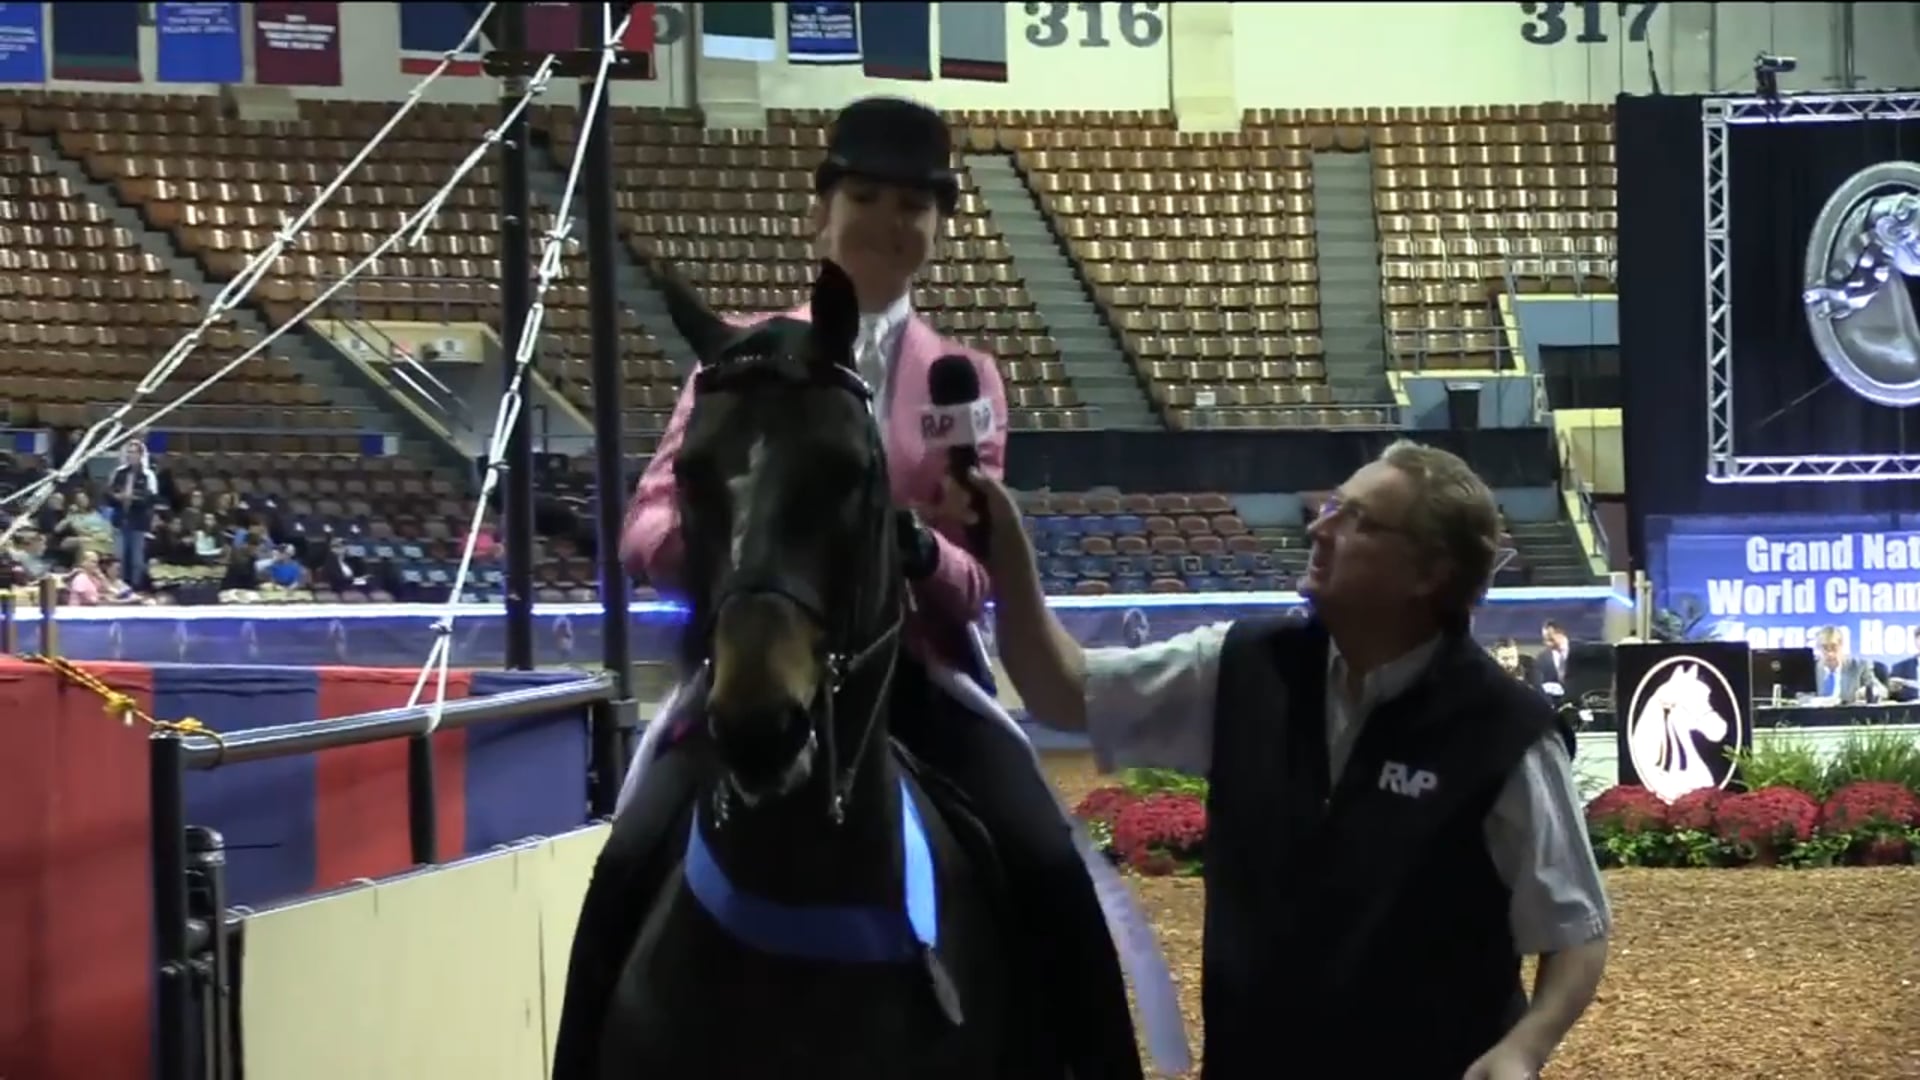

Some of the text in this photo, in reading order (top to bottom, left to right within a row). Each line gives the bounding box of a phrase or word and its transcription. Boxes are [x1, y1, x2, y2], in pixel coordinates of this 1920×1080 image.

[1025, 3, 1163, 48] 316
[1521, 3, 1658, 45] 317
[1746, 533, 1854, 573] Grand
[1707, 577, 1816, 616] World
[1378, 760, 1438, 798] RVP
